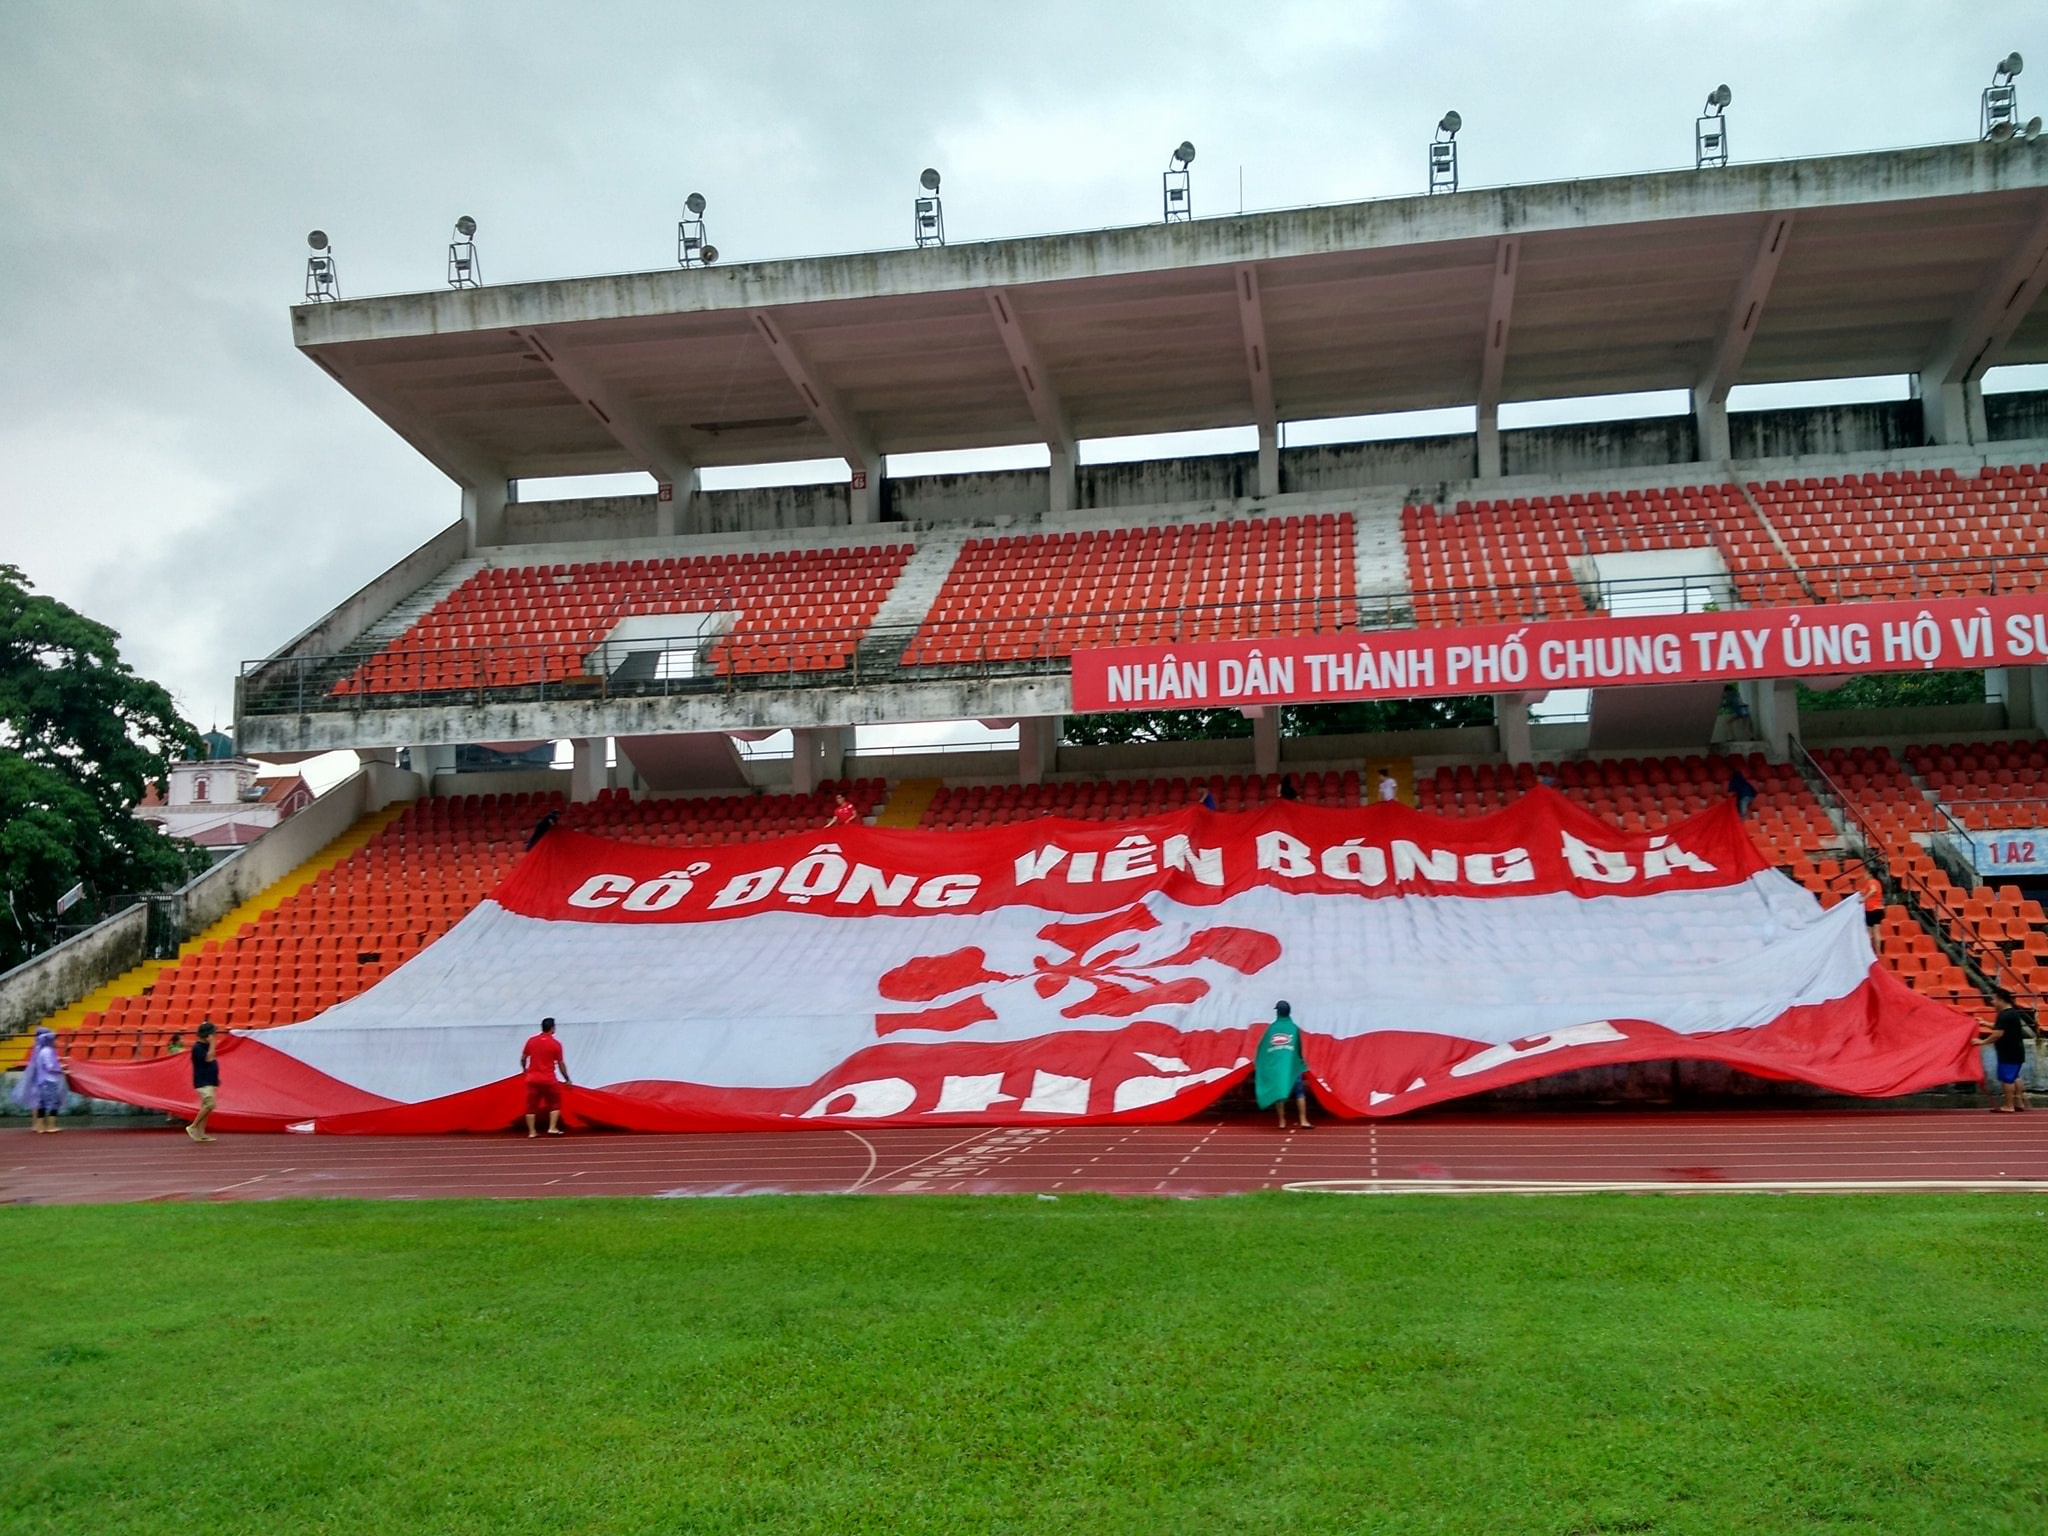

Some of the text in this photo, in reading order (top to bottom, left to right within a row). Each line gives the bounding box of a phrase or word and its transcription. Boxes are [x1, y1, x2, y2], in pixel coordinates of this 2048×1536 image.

[1107, 654, 1207, 703] NHÂN
[1218, 649, 1294, 697] DÂN
[1303, 643, 1434, 692] THÀNH
[1447, 628, 1529, 686] PHỐ
[1539, 633, 1682, 680] CHUNG
[1690, 628, 1771, 672] TAY
[1782, 614, 1872, 667] ỦNG
[1882, 610, 1941, 668] HỘ
[1951, 607, 1994, 658] VÌ
[567, 830, 1718, 911] CỔ ĐỘNG VIÊN BÓNG ĐÁ
[1989, 841, 2037, 864] 1 A2
